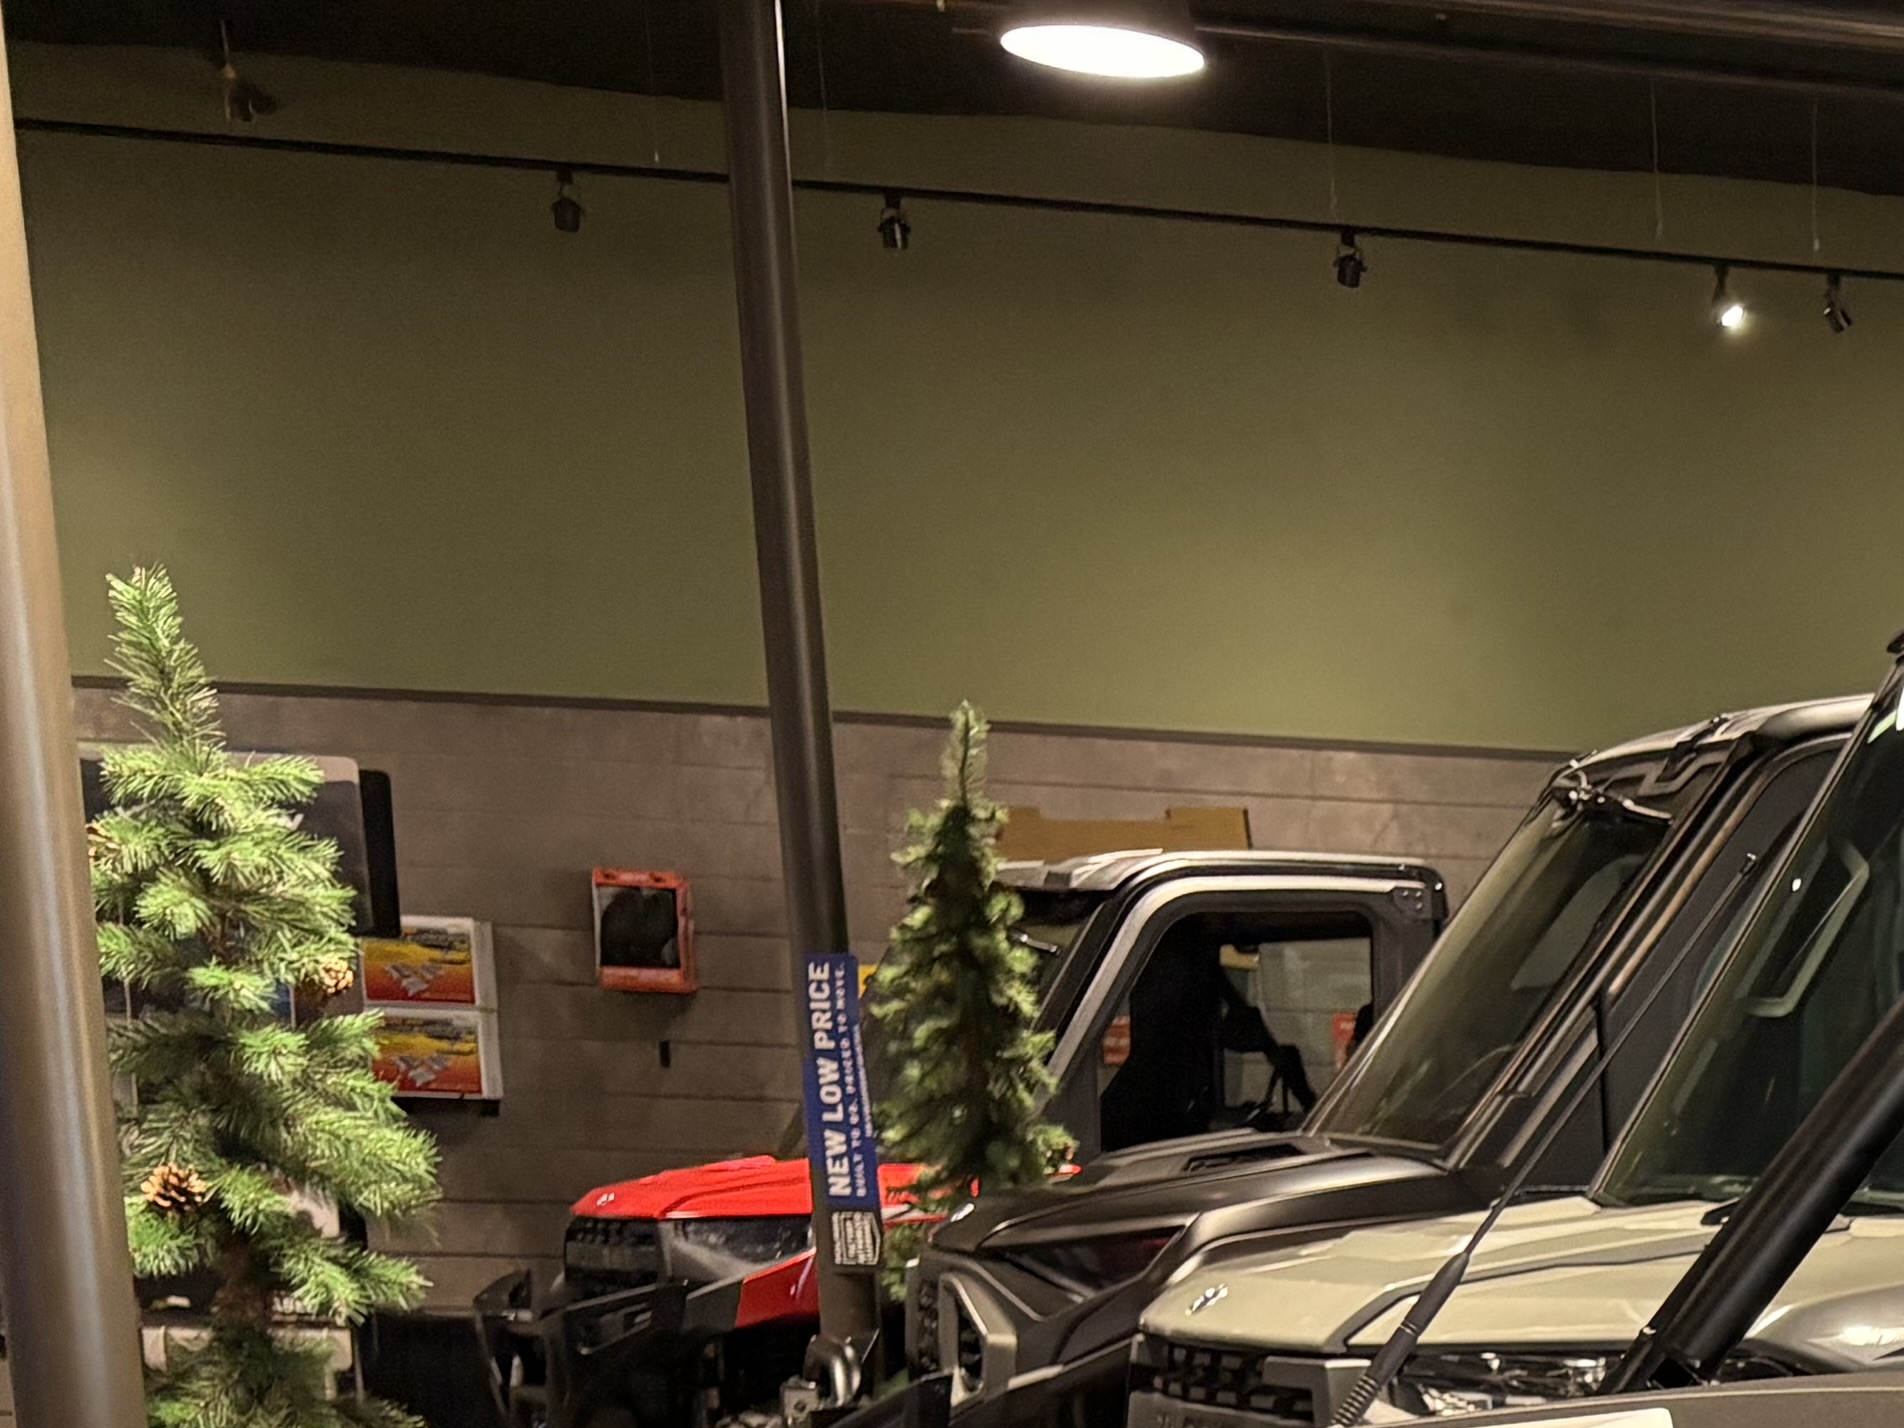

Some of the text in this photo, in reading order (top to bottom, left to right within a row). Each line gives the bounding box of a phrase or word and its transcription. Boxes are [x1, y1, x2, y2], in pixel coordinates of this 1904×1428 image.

[808, 961, 851, 1197] NEW LOW PRICE
